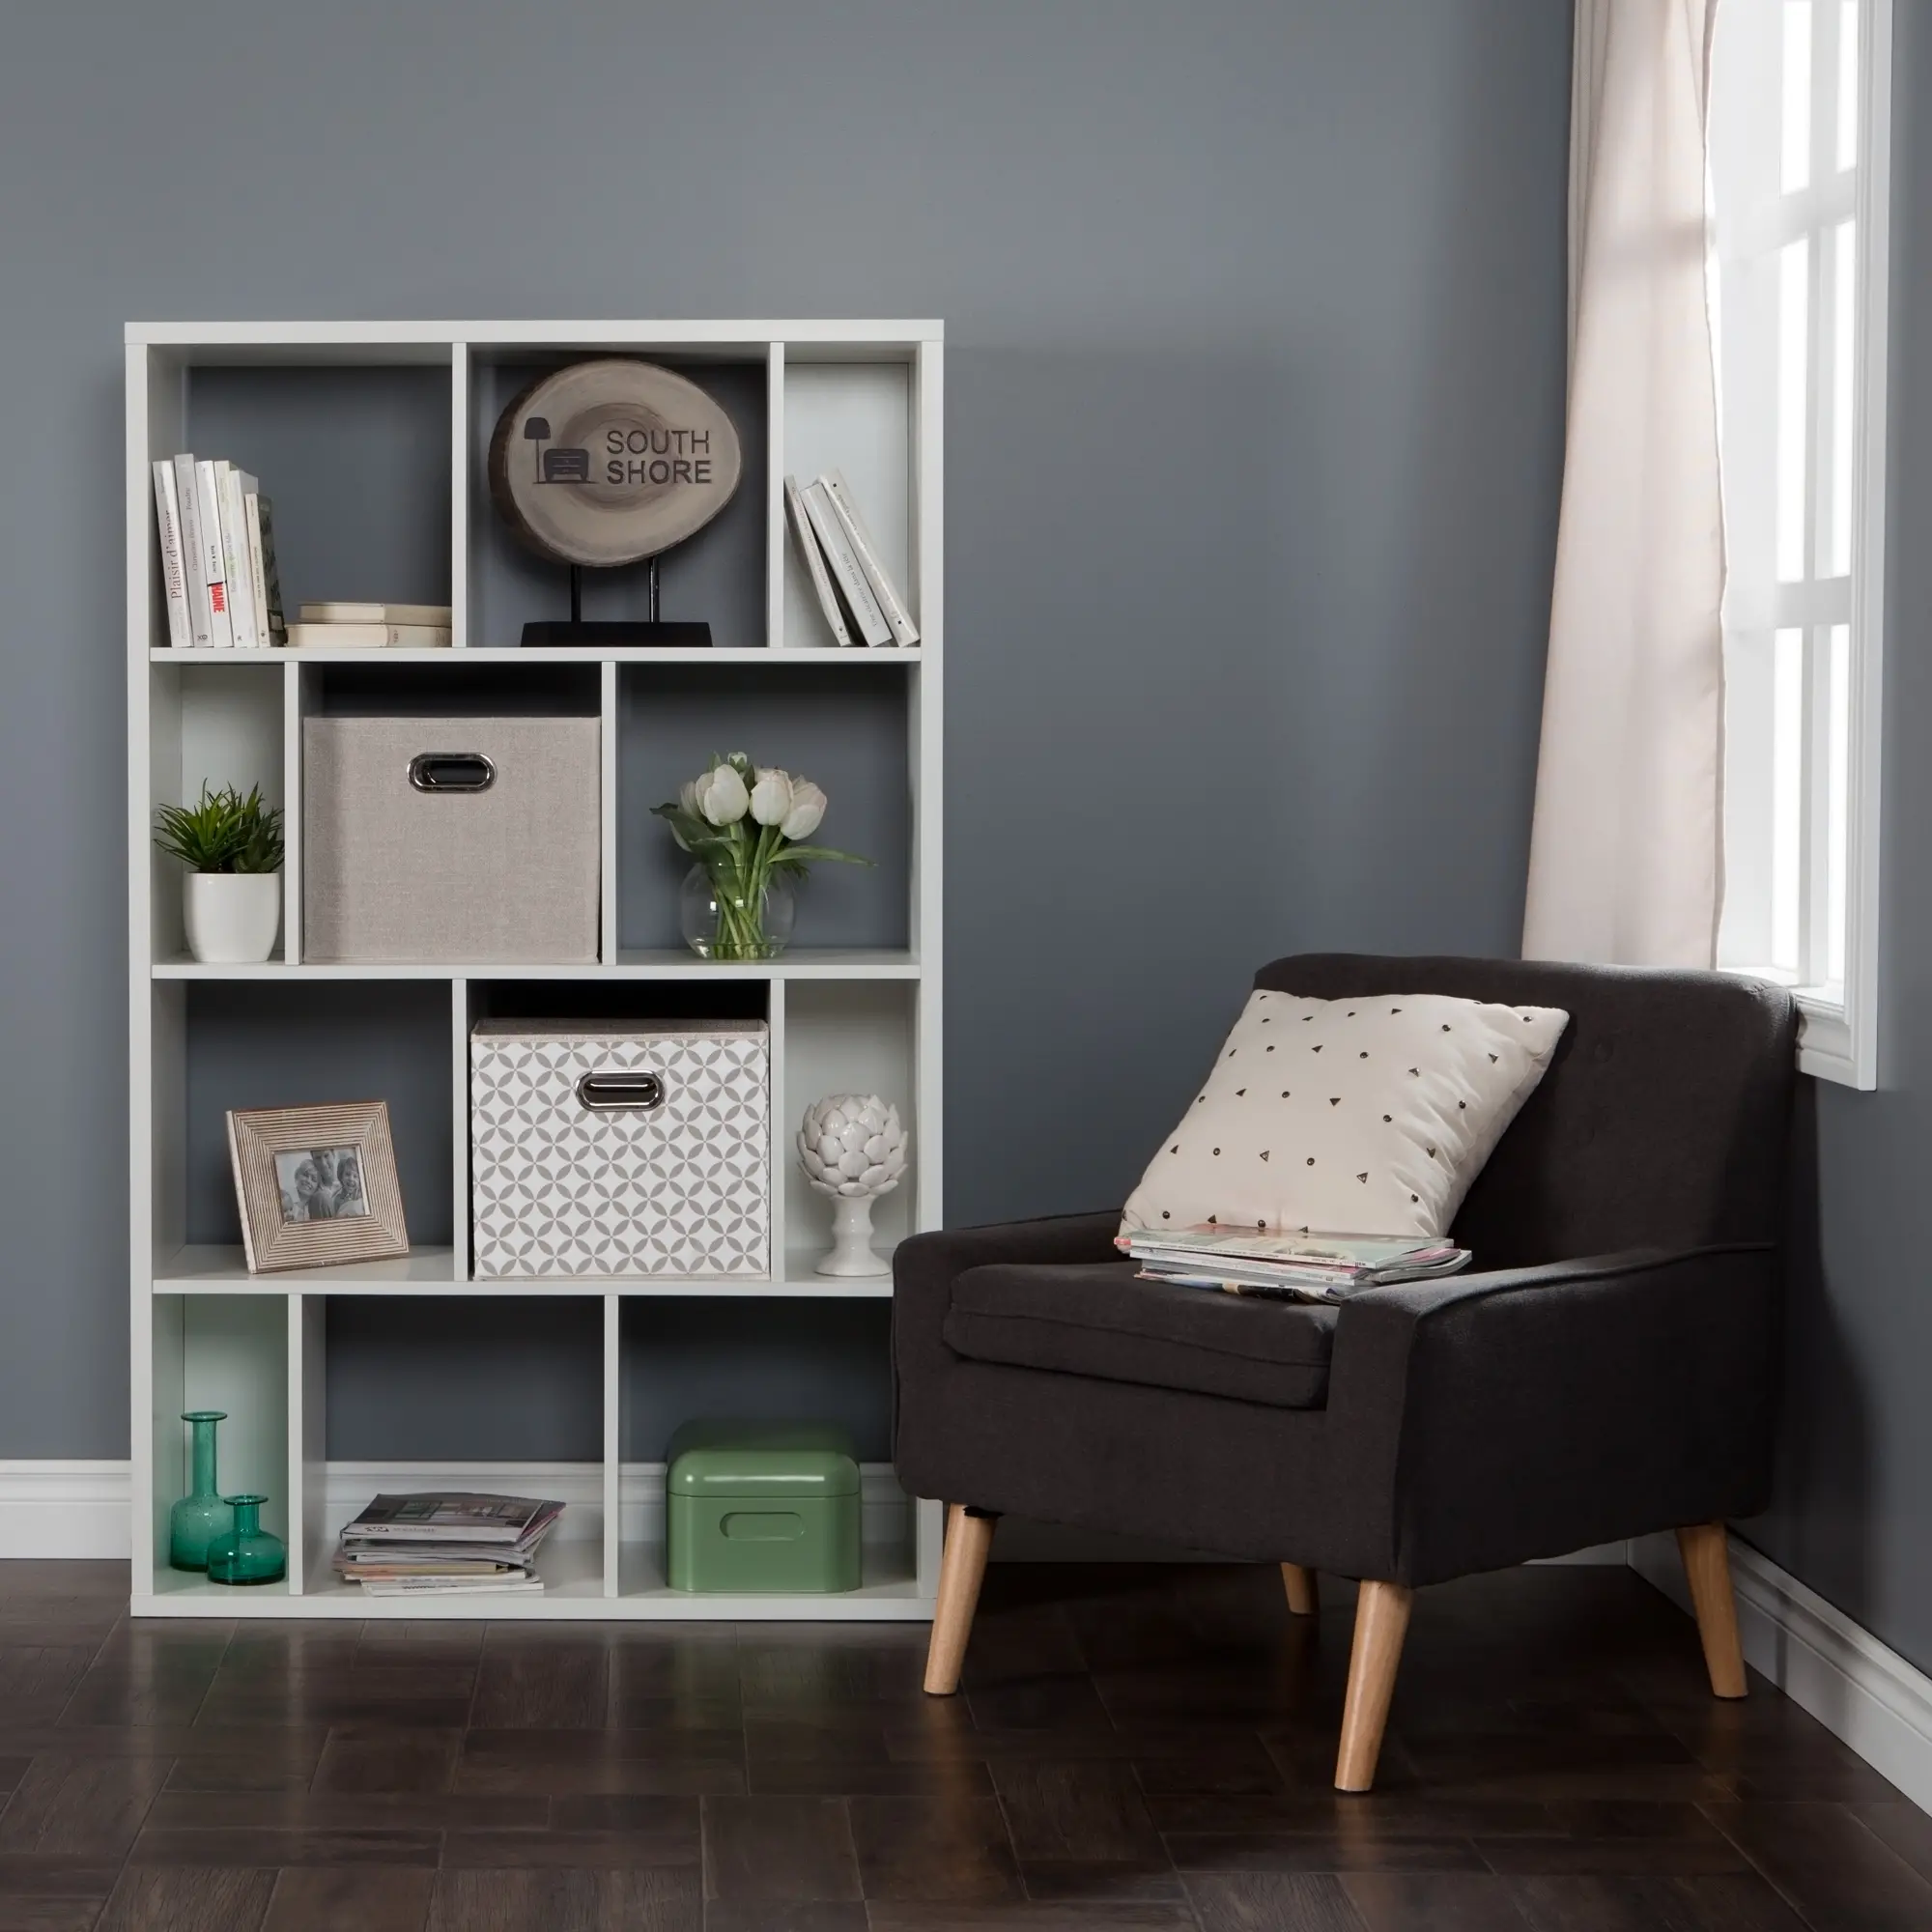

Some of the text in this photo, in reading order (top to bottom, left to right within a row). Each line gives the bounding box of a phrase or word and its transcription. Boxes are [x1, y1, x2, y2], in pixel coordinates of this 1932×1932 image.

[606, 430, 710, 455] SOUTH
[607, 460, 712, 485] SHORE
[168, 559, 183, 599] Plaisir
[212, 584, 225, 613] HAINE
